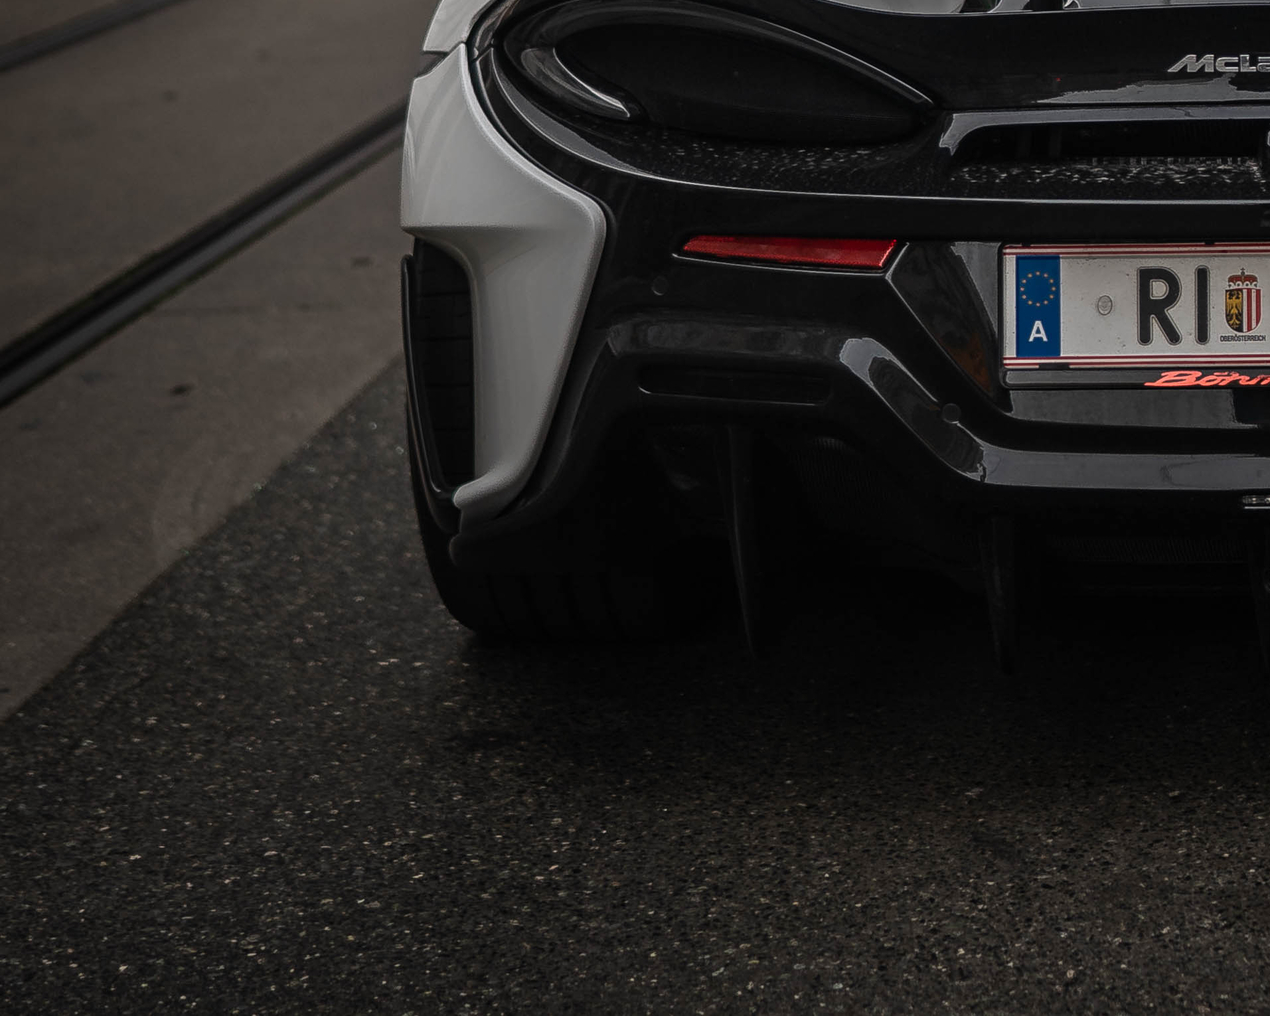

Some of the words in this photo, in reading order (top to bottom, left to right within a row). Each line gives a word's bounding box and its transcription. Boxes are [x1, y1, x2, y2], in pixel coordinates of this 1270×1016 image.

[1137, 265, 1211, 345] RI
[1028, 320, 1048, 342] A
[1219, 333, 1267, 343] OBERÖSTERREICH
